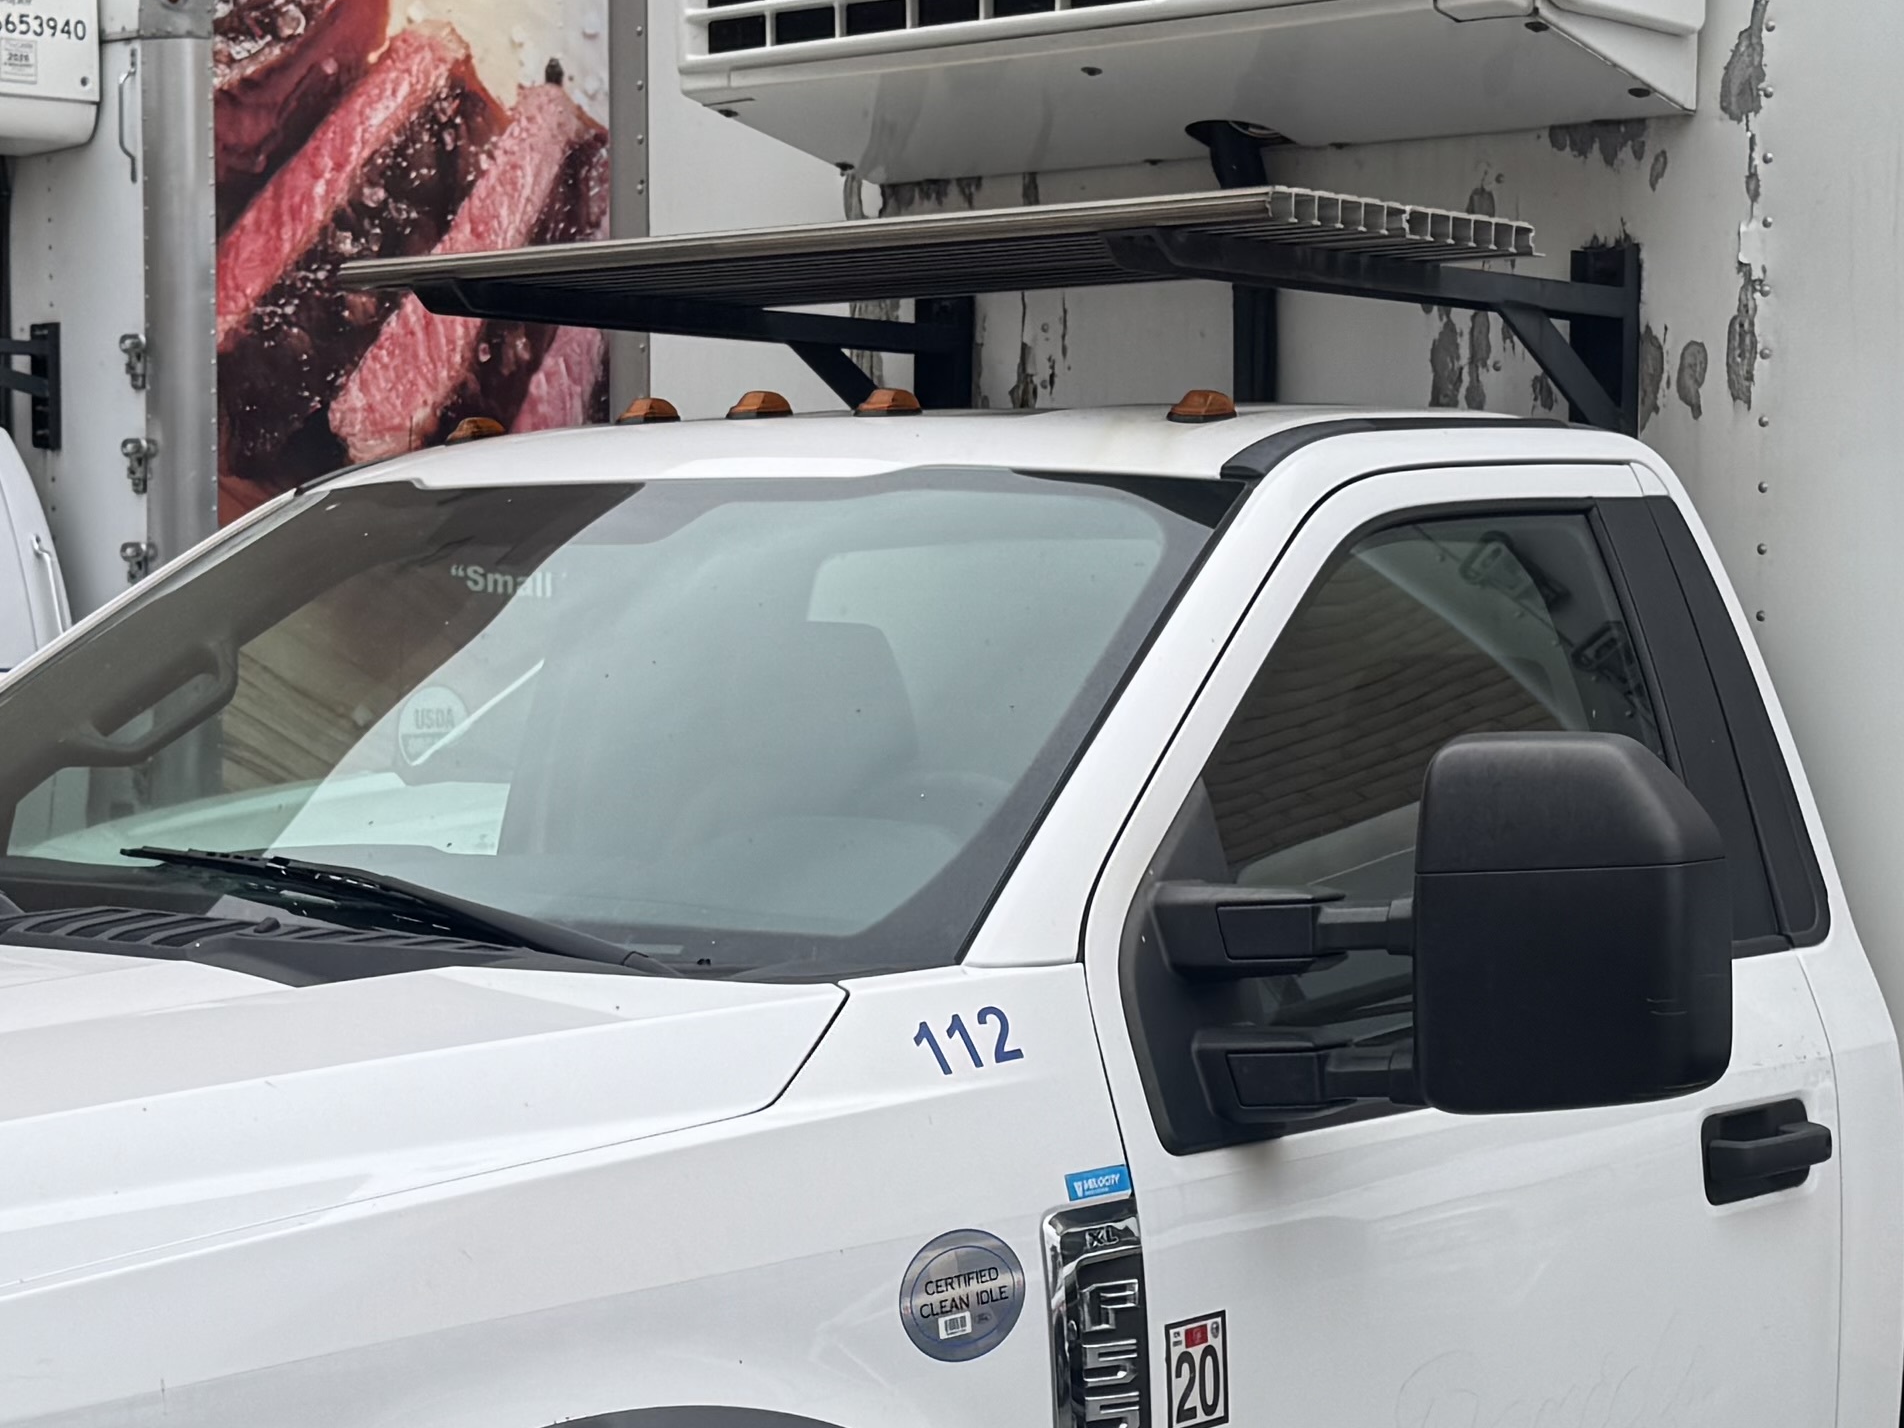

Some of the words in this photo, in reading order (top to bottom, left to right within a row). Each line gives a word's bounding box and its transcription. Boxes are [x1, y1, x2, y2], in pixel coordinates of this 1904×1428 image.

[414, 707, 455, 730] USDA
[913, 1006, 1024, 1075] 112
[1085, 1225, 1119, 1249] XL
[924, 1266, 999, 1296] CERTIFIED
[919, 1293, 970, 1319] CLEAN
[976, 1285, 1009, 1306] IDLE
[1175, 1344, 1221, 1424] 20
